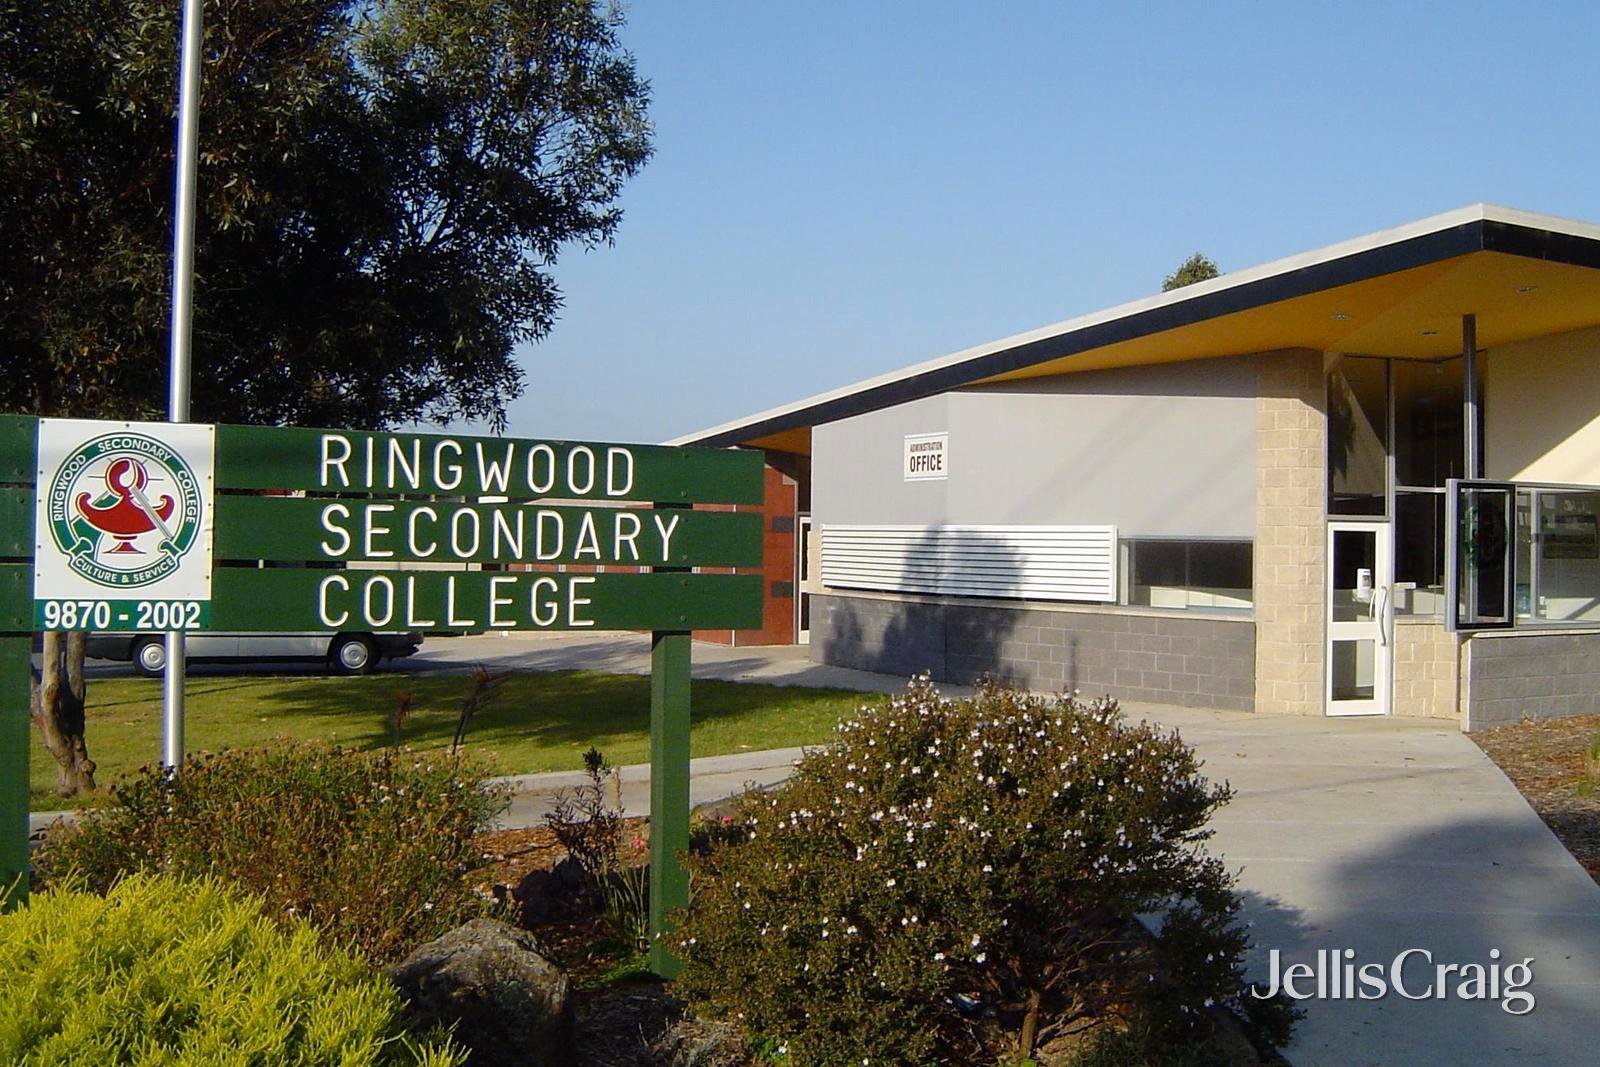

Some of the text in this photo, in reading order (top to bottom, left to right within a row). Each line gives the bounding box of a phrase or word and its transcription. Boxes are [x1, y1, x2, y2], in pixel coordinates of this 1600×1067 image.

[54, 438, 196, 523] RINGWOOD SECONDARY COLLEGE
[320, 434, 633, 497] RINGWOOD
[910, 454, 942, 472] OFFICE
[320, 503, 679, 562] SECONDARY
[75, 556, 175, 583] CULTURE & SERVICE
[44, 600, 110, 629] 9870
[136, 601, 201, 629] 2002
[318, 574, 596, 627] COLLEGE
